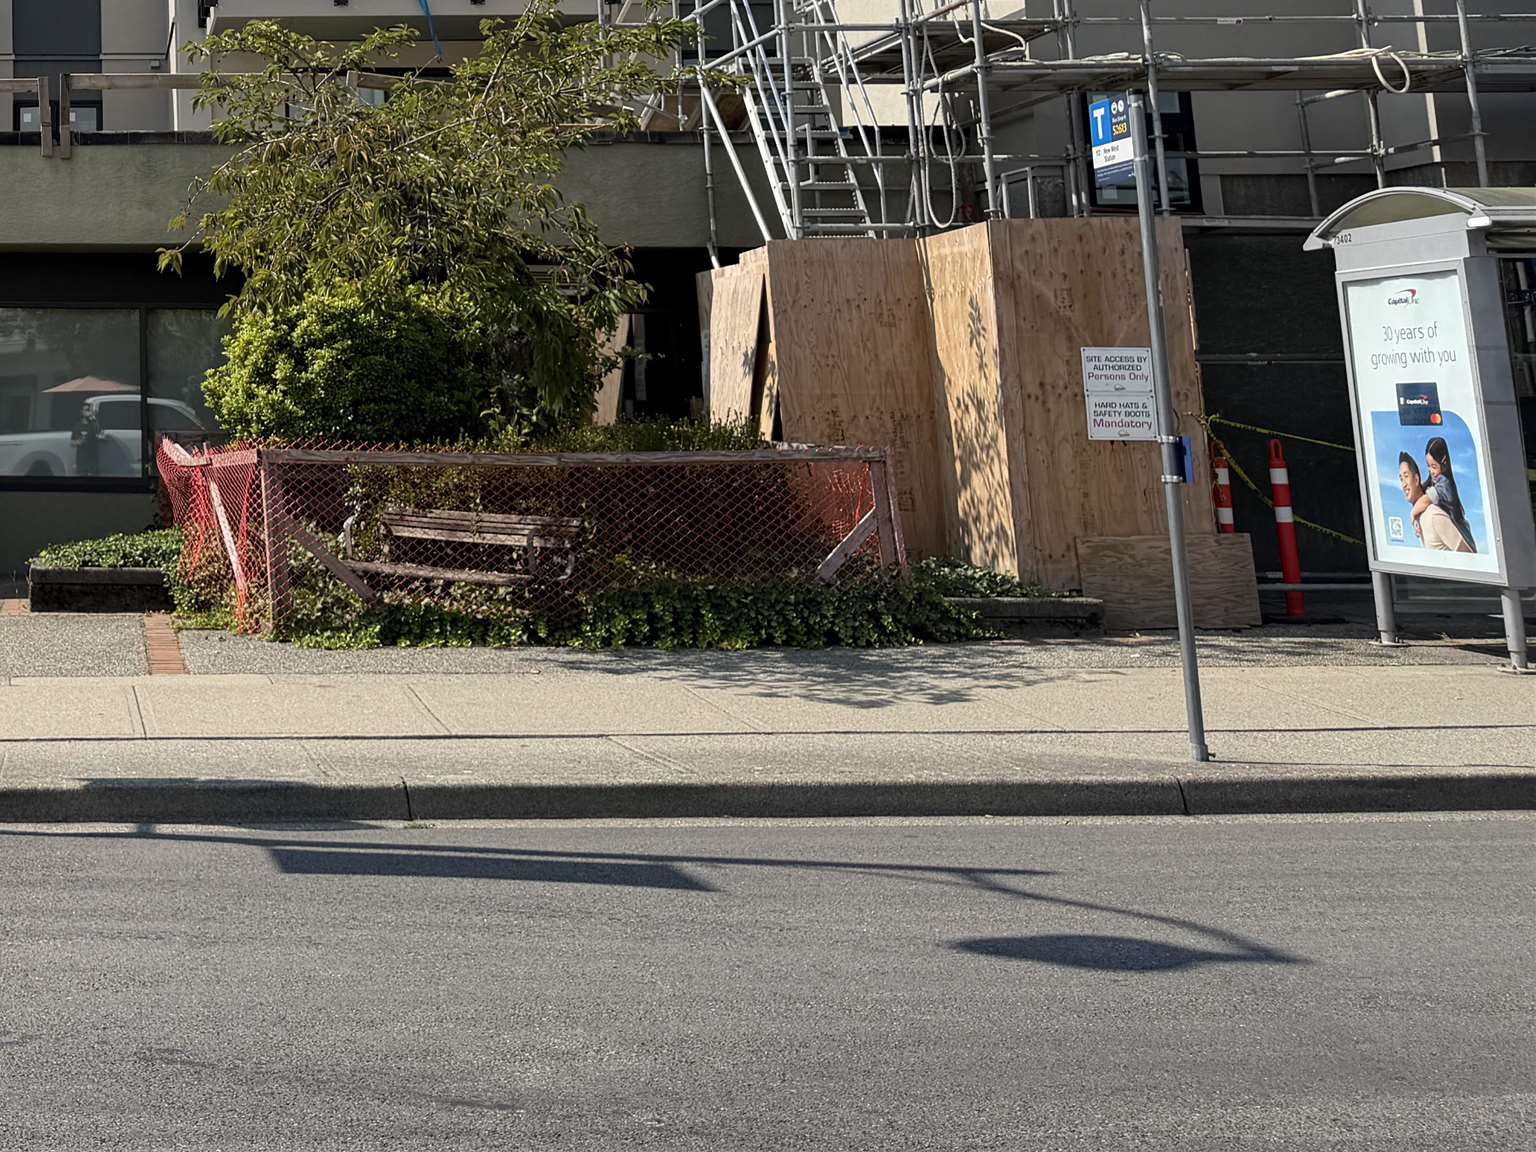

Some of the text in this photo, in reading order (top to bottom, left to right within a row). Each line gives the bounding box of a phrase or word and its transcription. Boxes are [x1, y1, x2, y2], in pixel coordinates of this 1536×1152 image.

[1382, 321, 1439, 344] 30 years of
[1104, 355, 1135, 363] ACCESS
[1370, 347, 1457, 370] growing with you
[1087, 372, 1149, 382] Persons Only
[1124, 410, 1150, 418] BOOTS
[1093, 418, 1152, 430] Mandatory
